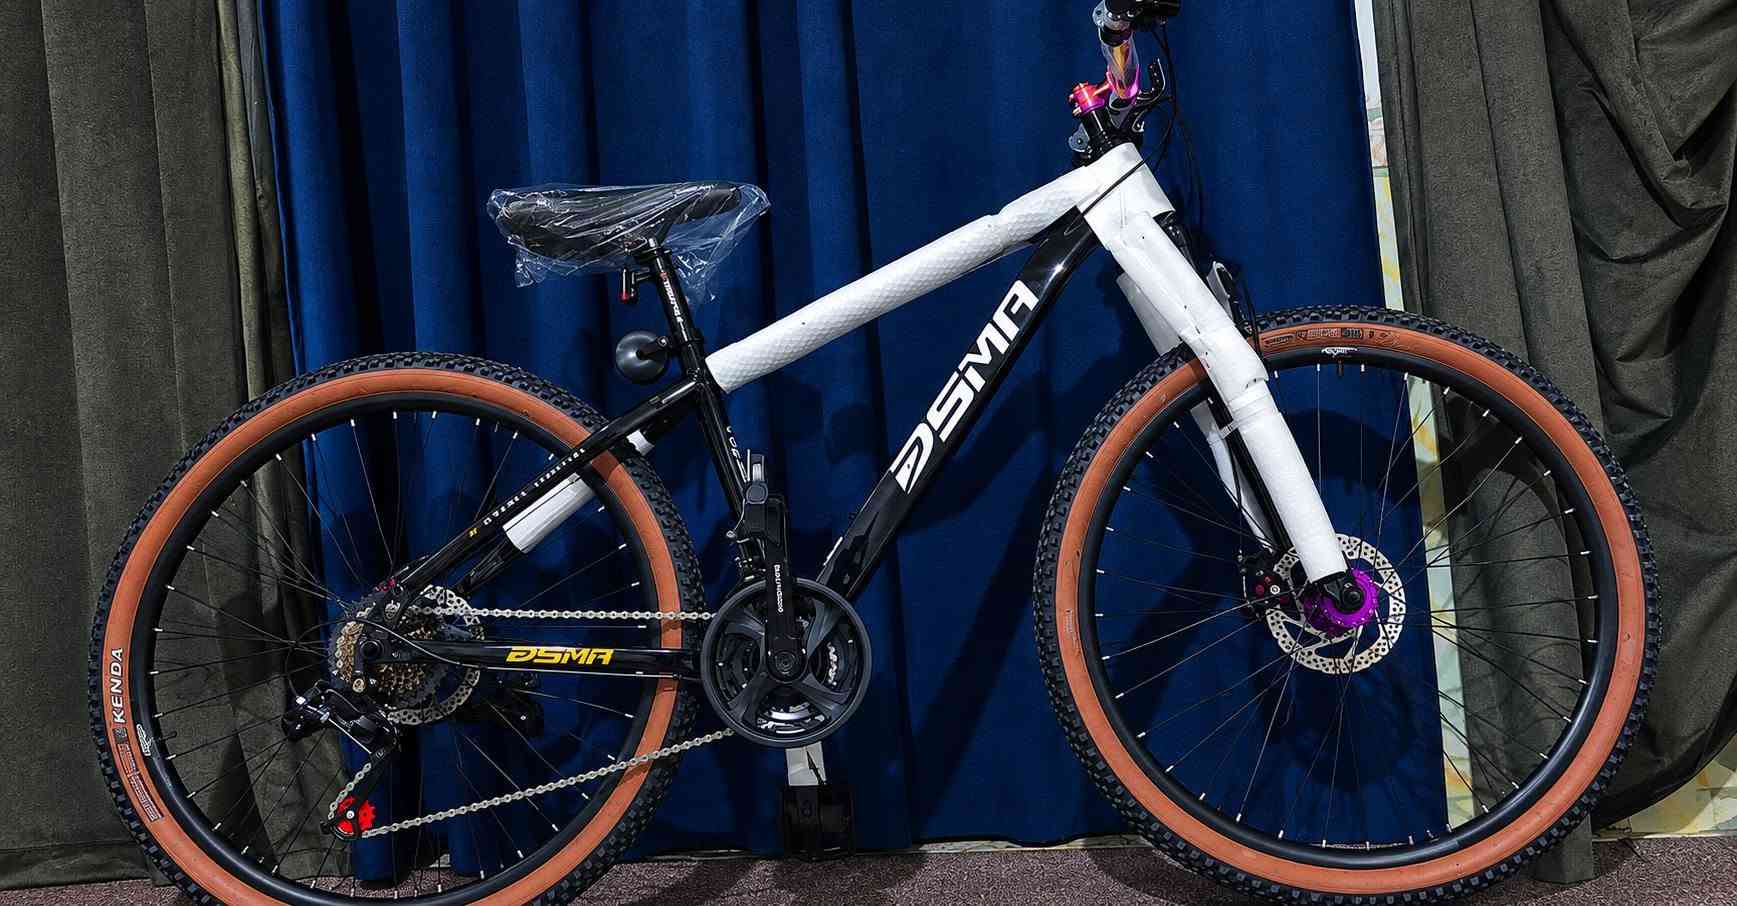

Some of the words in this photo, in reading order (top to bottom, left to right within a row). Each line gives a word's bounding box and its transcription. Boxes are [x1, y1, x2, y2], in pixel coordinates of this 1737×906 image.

[891, 279, 1040, 495] DSMA
[110, 647, 126, 725] KENDA
[506, 646, 614, 665] DSMA
